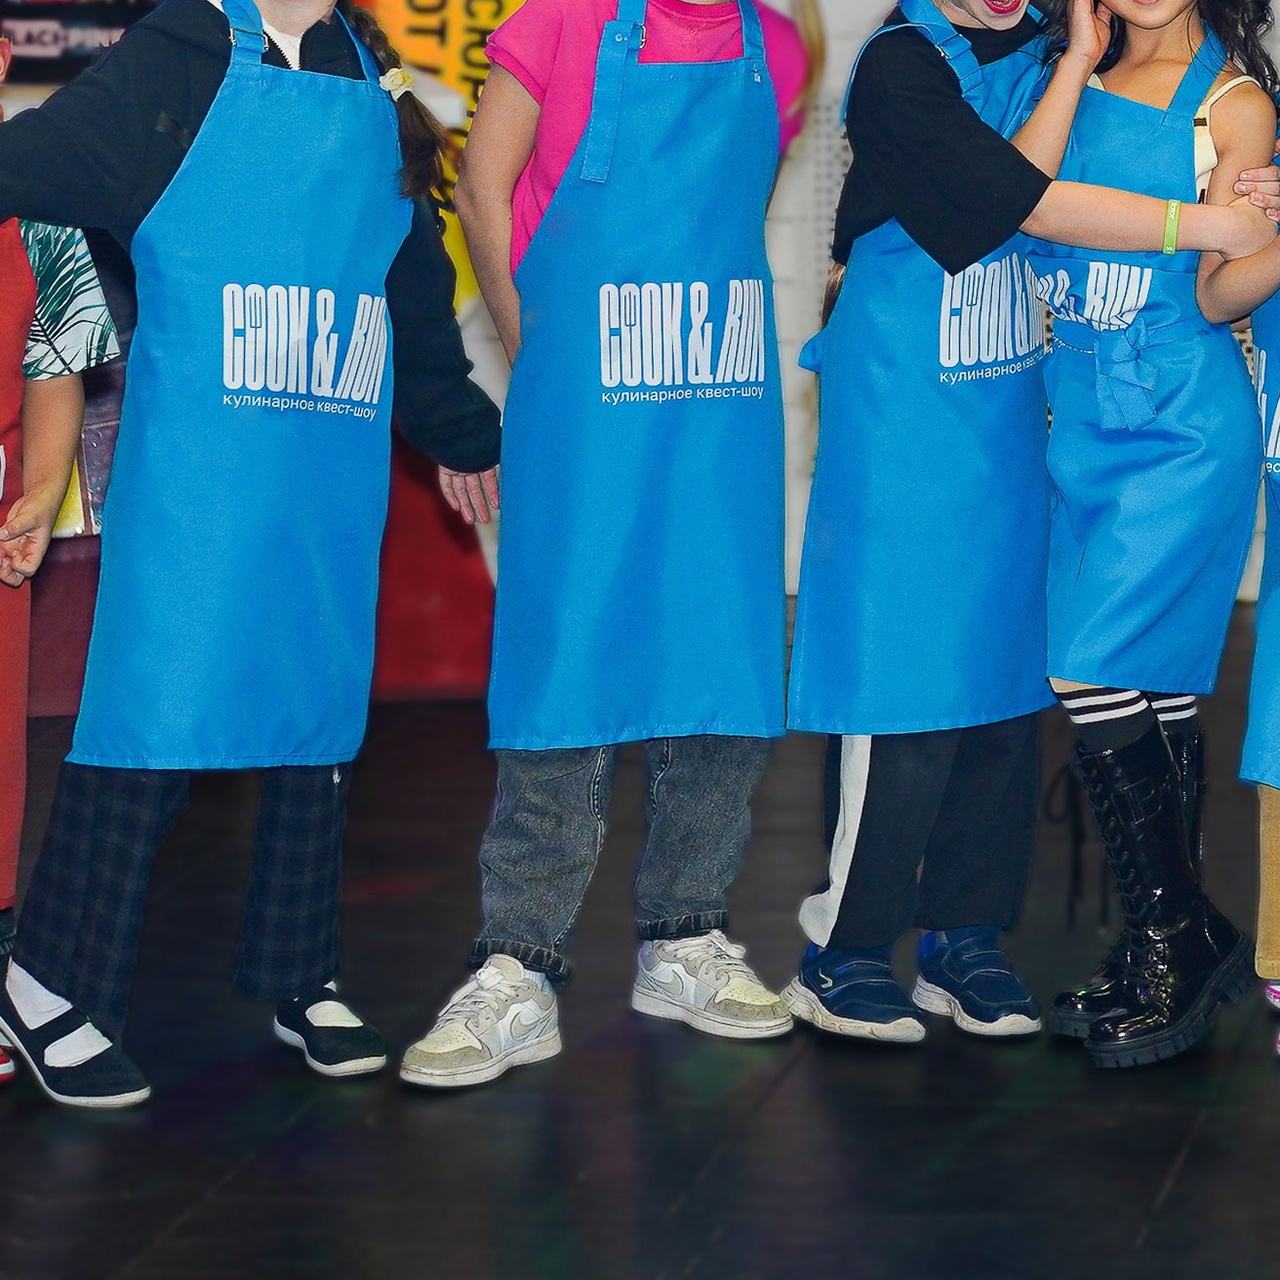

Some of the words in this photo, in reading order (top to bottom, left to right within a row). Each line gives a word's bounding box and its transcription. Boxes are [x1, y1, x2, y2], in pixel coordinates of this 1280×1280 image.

[939, 256, 1013, 368] COOK
[1084, 261, 1153, 332] RUN
[222, 283, 310, 394] COOK
[311, 288, 338, 398] &
[334, 293, 388, 404] RUN
[599, 282, 683, 387] COOK
[687, 281, 713, 384] &
[715, 279, 765, 383] RUN
[223, 394, 314, 411] кулинарное
[317, 401, 377, 421] квест-шоу
[602, 388, 692, 406] кулинарное
[697, 386, 764, 400] квест-шоу
[940, 361, 1022, 385] кулинарное
